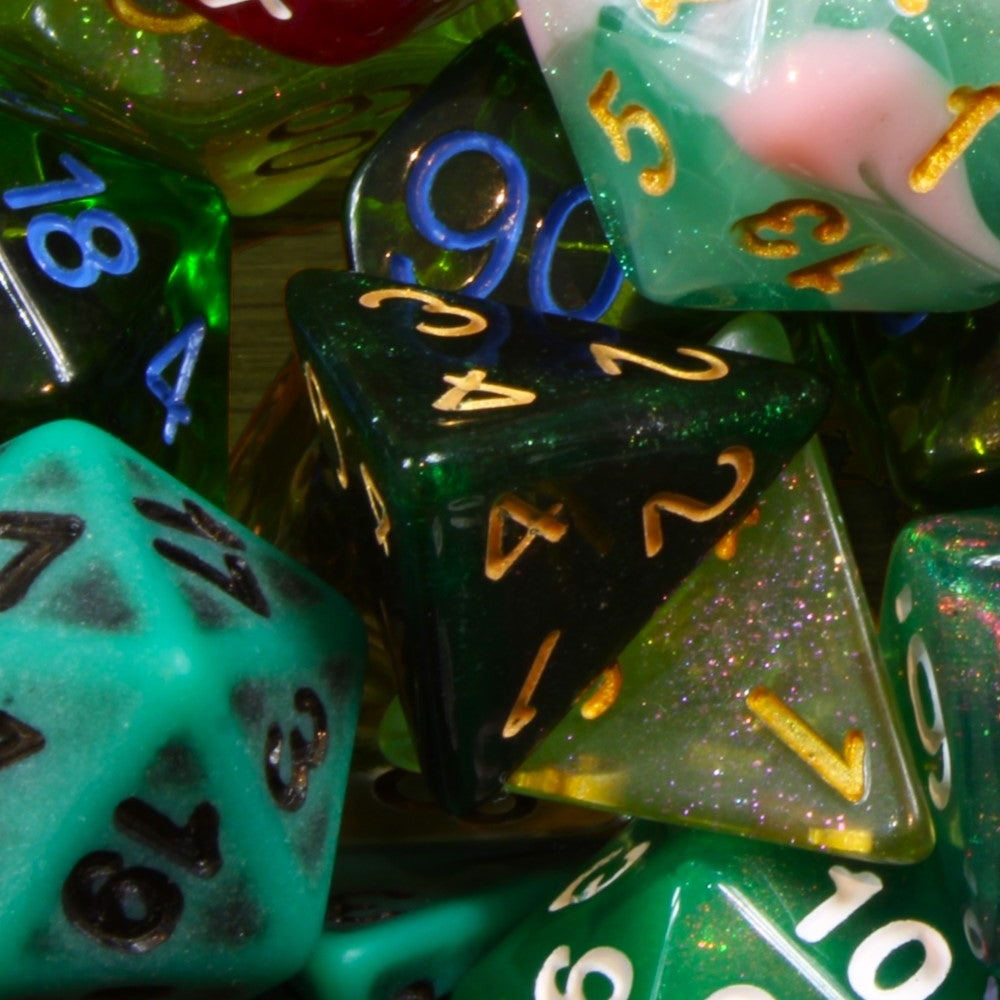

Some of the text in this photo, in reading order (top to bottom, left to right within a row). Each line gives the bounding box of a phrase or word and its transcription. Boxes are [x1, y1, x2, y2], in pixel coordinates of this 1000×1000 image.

[587, 68, 676, 197] 5
[2, 152, 141, 290] 18
[730, 198, 892, 296] 13
[485, 490, 570, 582] 4
[794, 865, 953, 1000] 10
